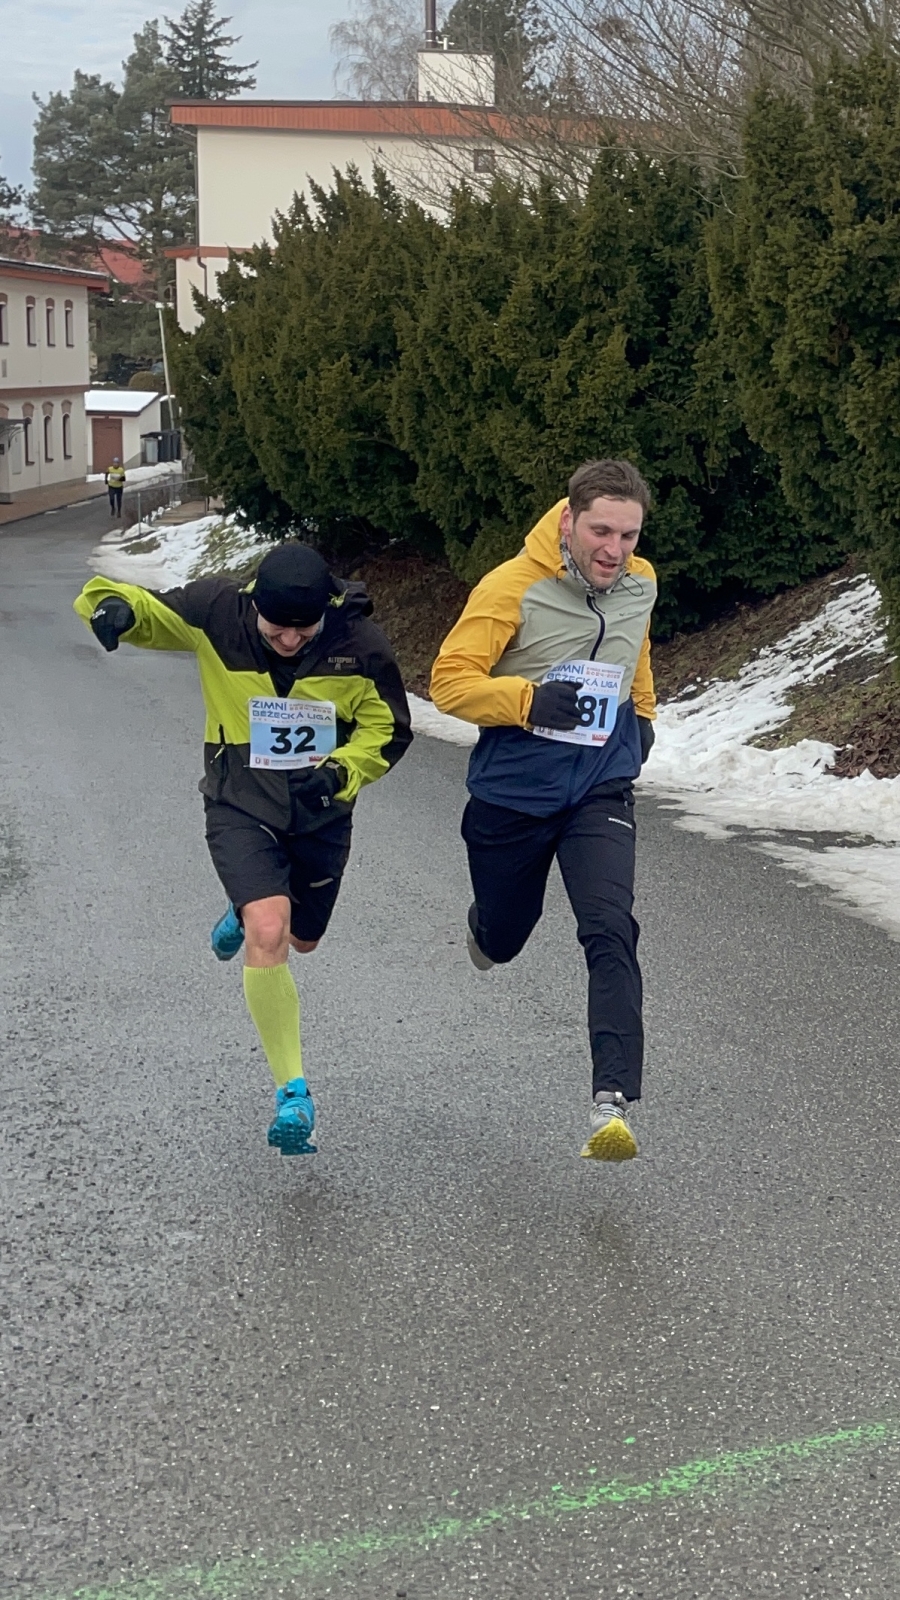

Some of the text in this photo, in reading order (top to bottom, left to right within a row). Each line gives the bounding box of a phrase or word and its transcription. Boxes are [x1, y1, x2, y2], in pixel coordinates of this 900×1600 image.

[601, 680, 618, 689] LIGA
[252, 700, 287, 711] ZIMNÍ
[252, 709, 304, 720] BĚŽECKÁ
[307, 713, 332, 721] LIGA
[269, 725, 316, 755] 32
